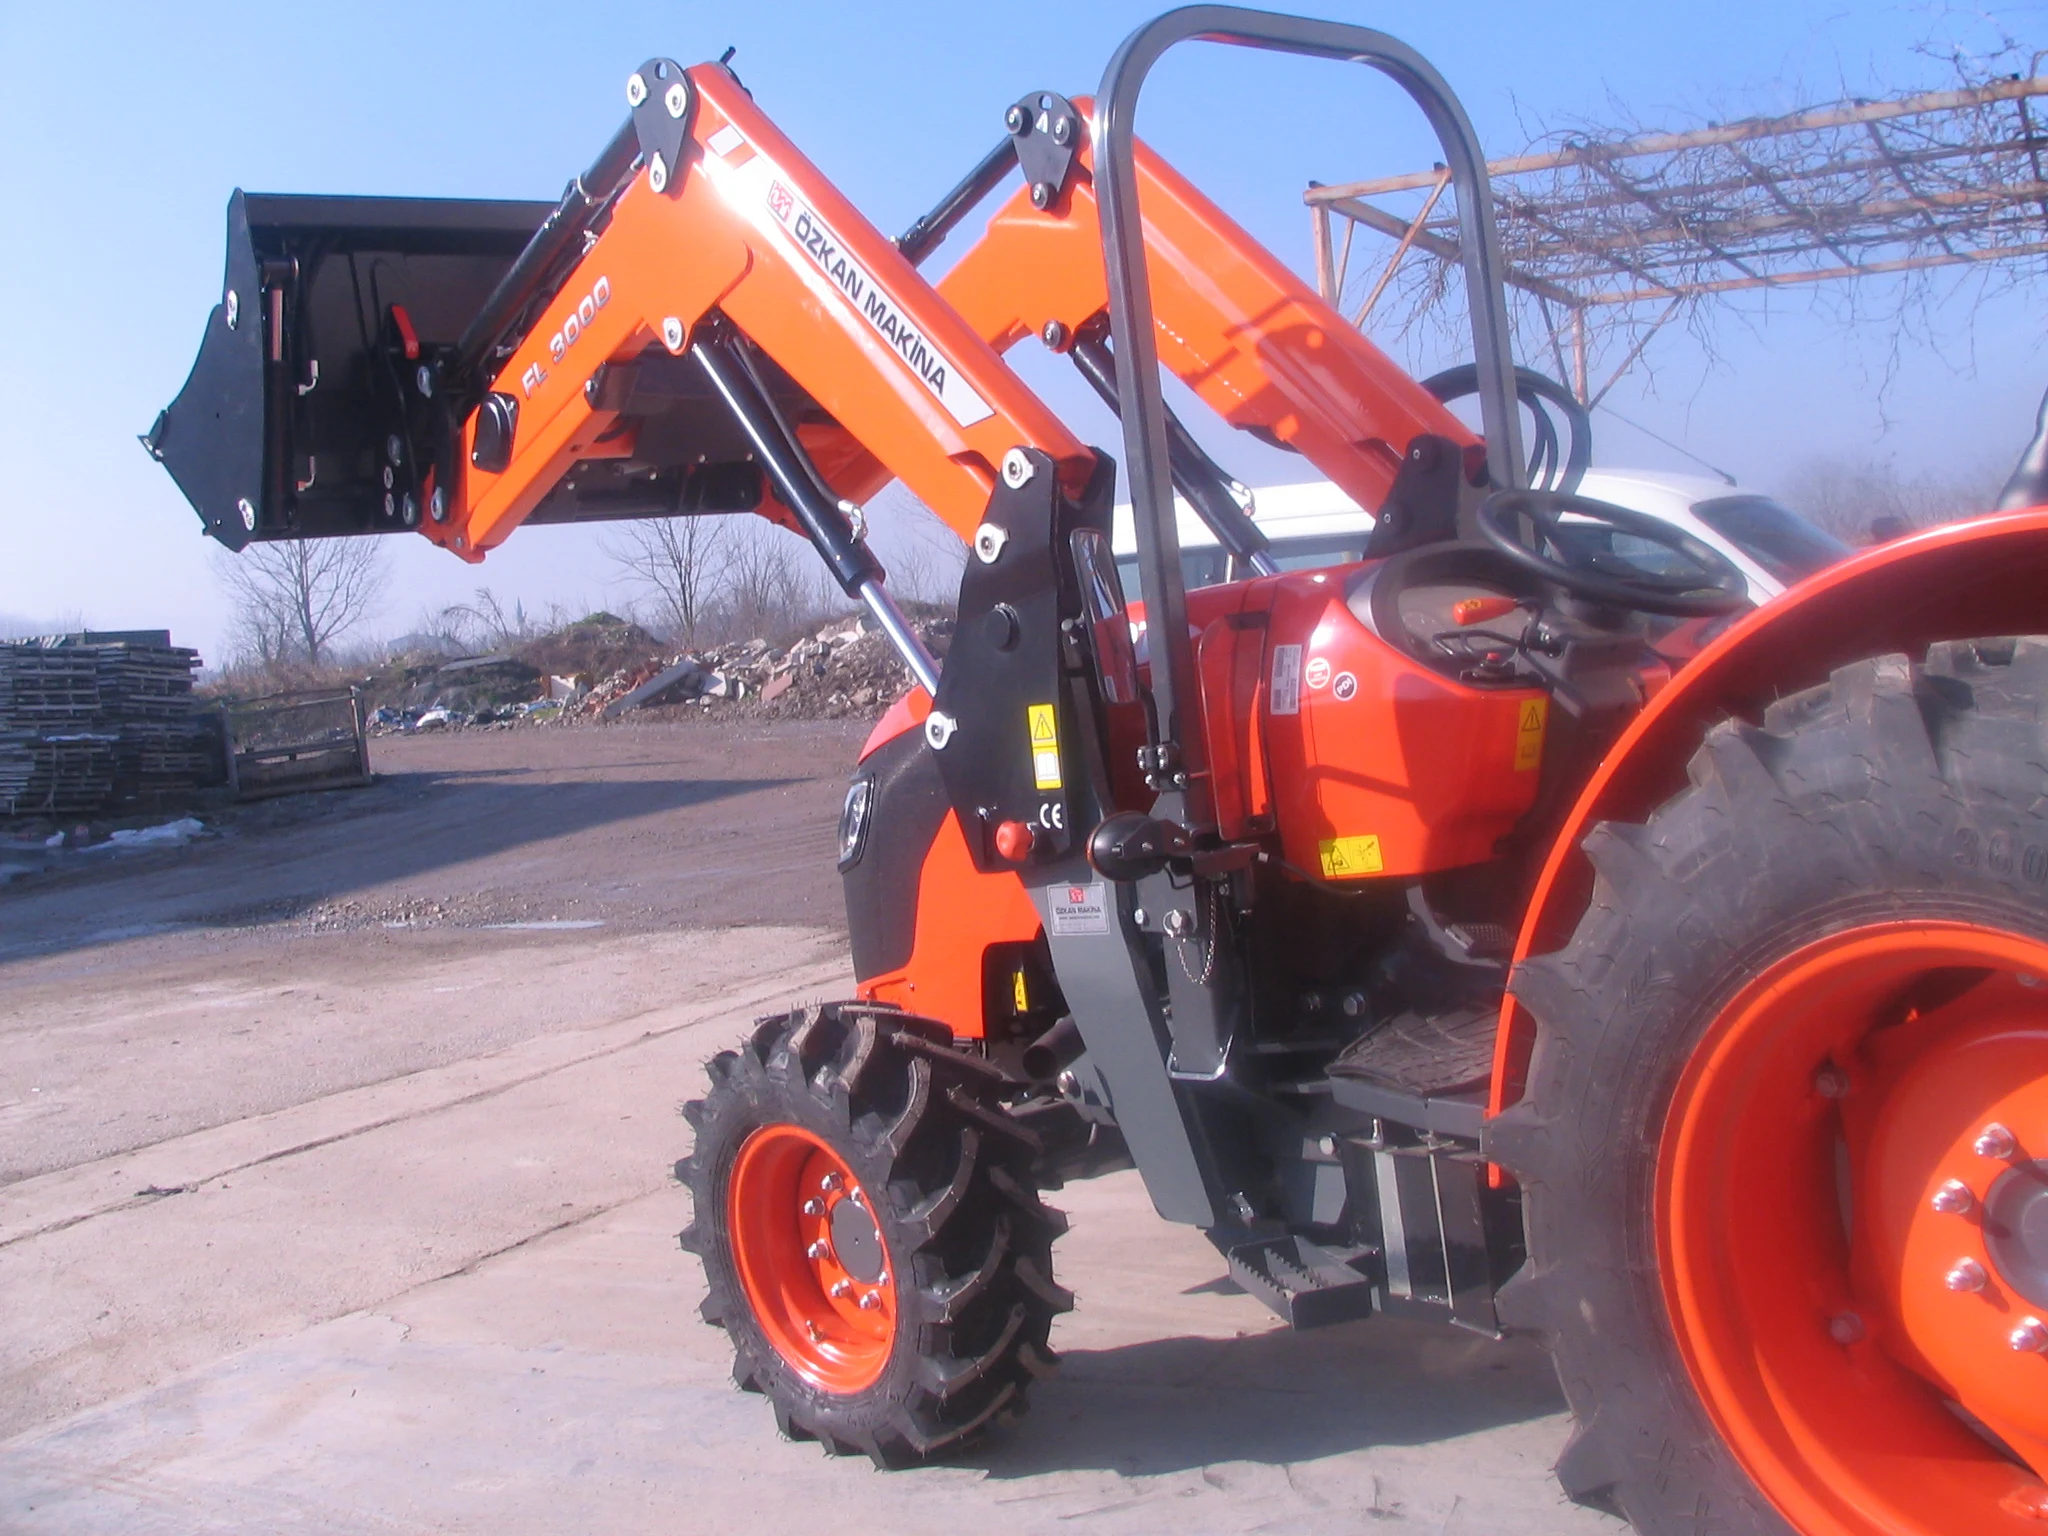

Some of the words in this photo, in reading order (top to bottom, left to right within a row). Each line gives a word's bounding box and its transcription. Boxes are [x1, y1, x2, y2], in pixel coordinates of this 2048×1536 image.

[521, 361, 548, 400] FL
[549, 275, 611, 366] 3000
[794, 210, 864, 301] ÖZKAN
[863, 290, 947, 397] MAKİNA
[1039, 802, 1063, 829] CE
